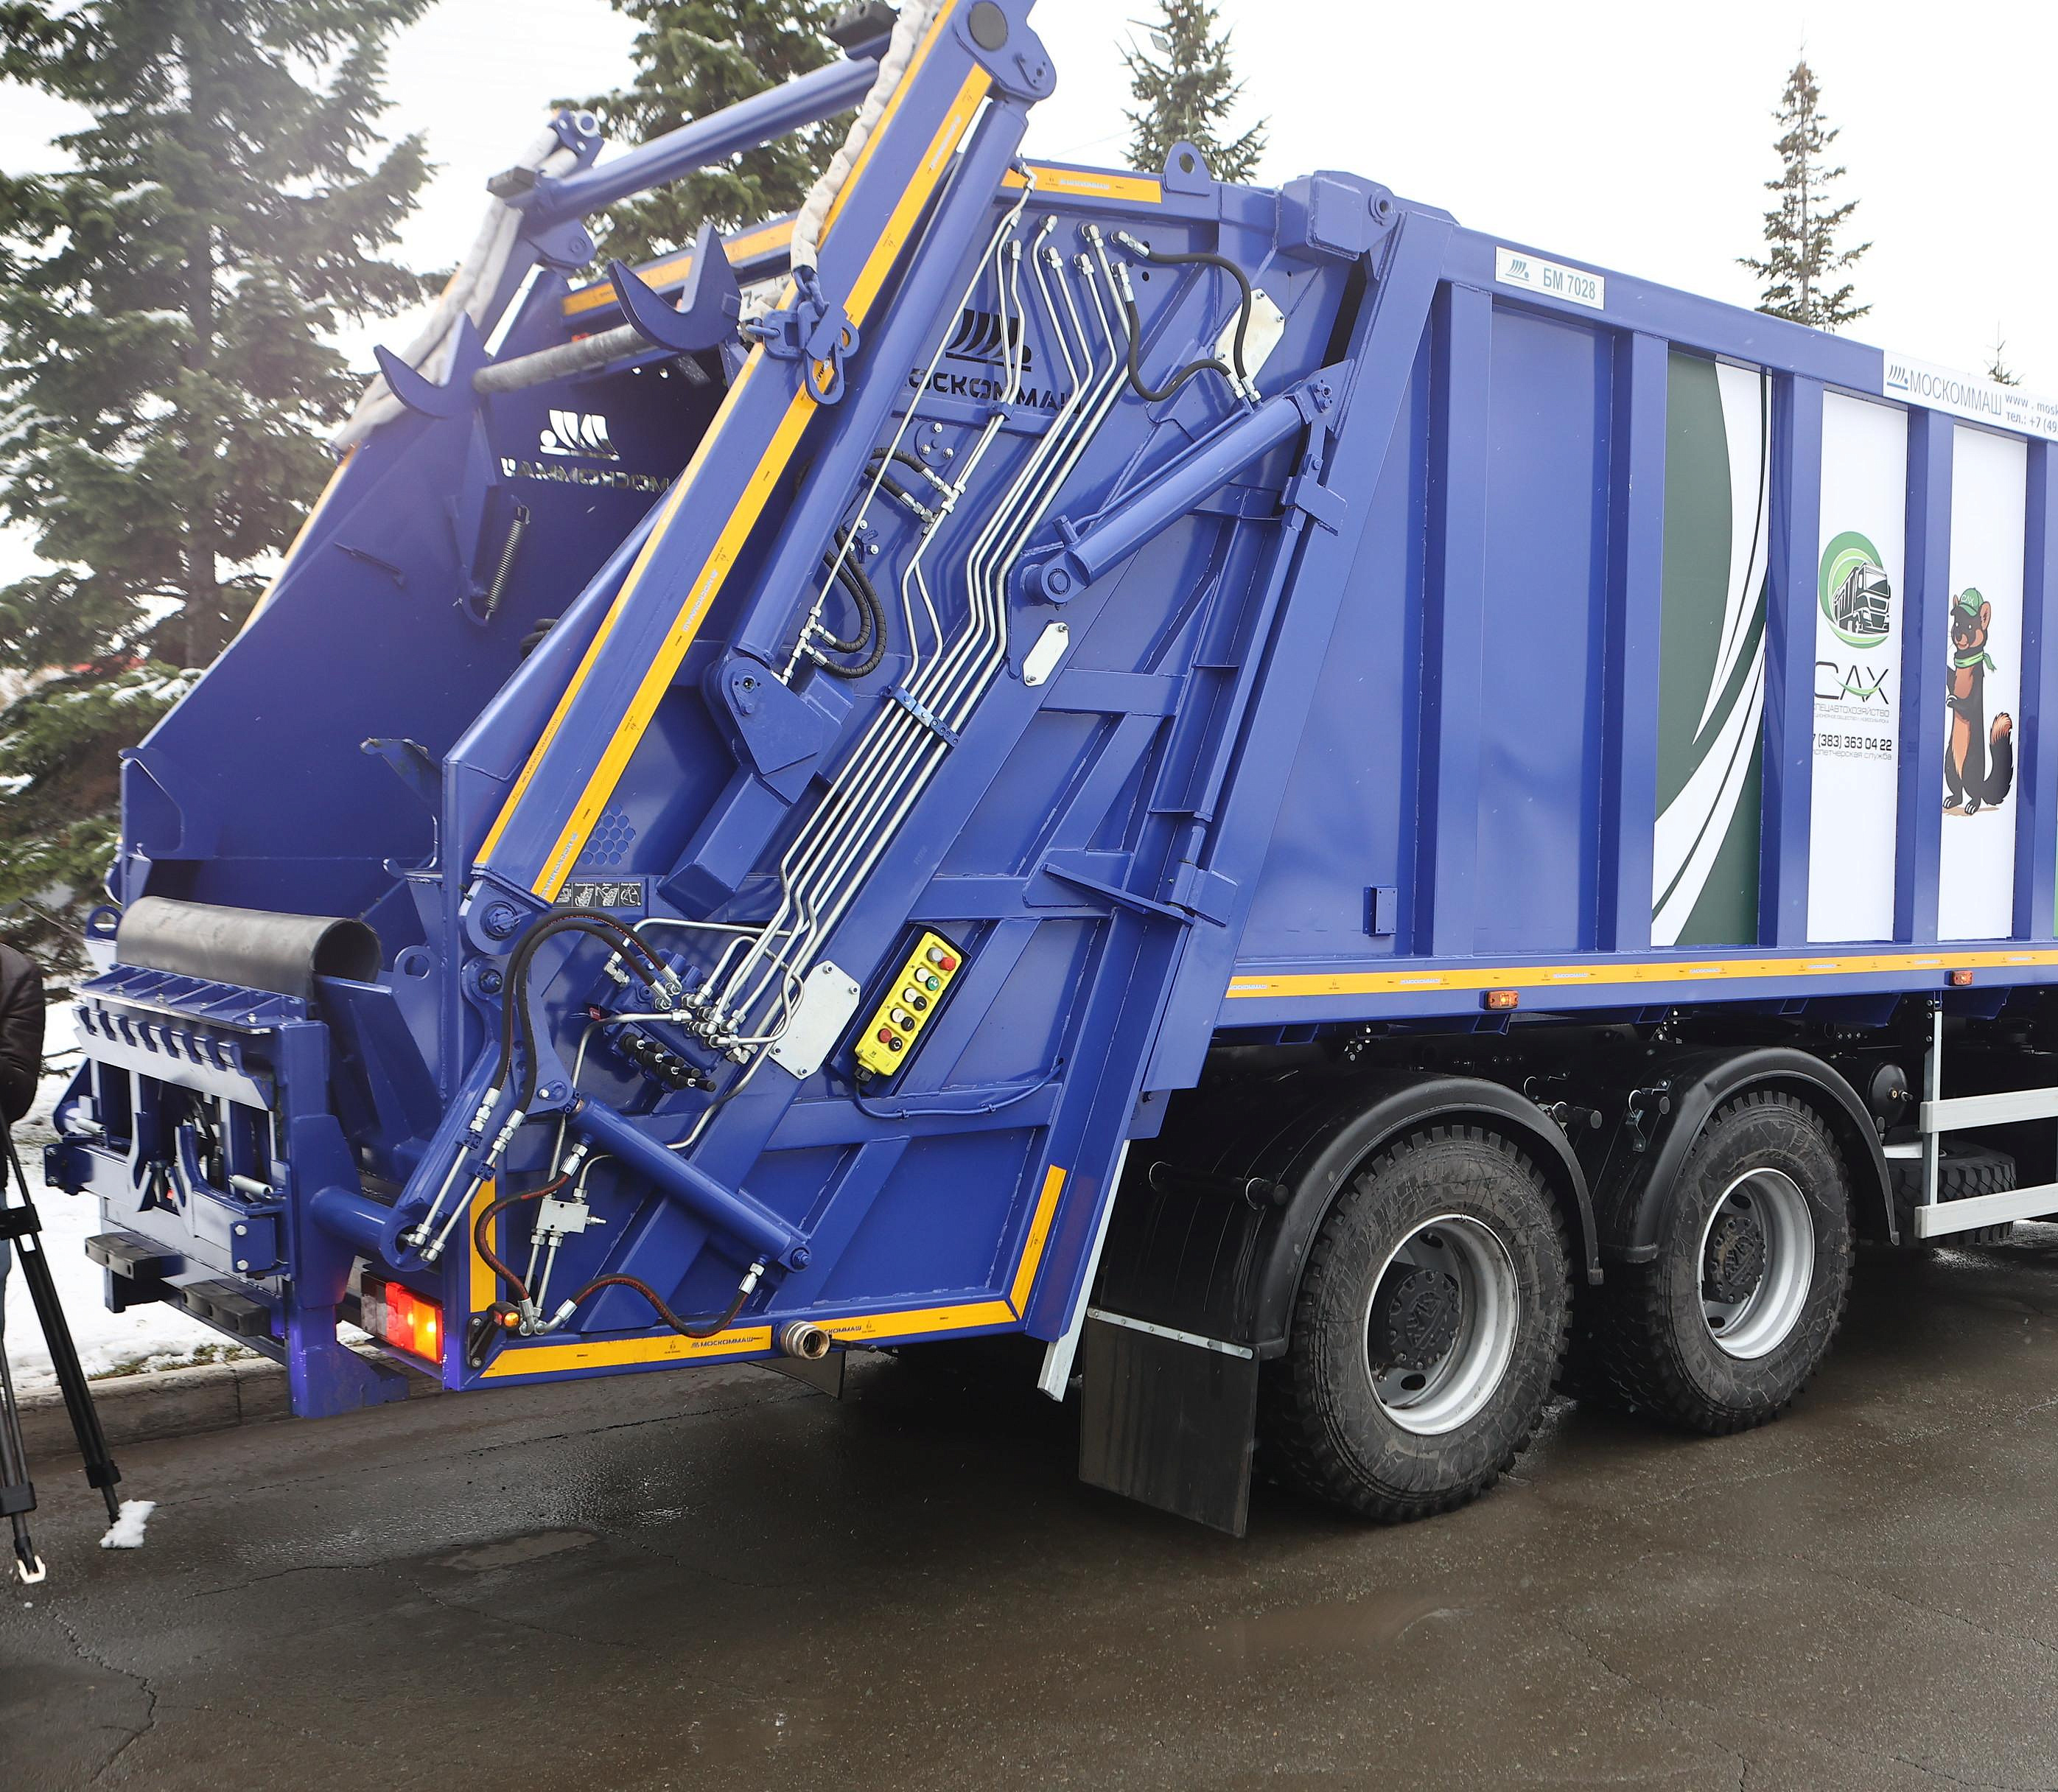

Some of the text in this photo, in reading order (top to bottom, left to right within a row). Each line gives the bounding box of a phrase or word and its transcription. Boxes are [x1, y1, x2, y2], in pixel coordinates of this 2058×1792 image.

[1543, 267, 1595, 300] БМ 7028
[1910, 370, 2002, 416] МОСКОММАШ
[2030, 416, 2041, 428] +7
[1814, 703, 1890, 718] ПЕЦАВТОХОЗЯЙСТВО
[1818, 733, 1841, 749] (383)
[1844, 736, 1863, 749] 363
[1865, 738, 1877, 750] 04
[1880, 739, 1892, 752] 22
